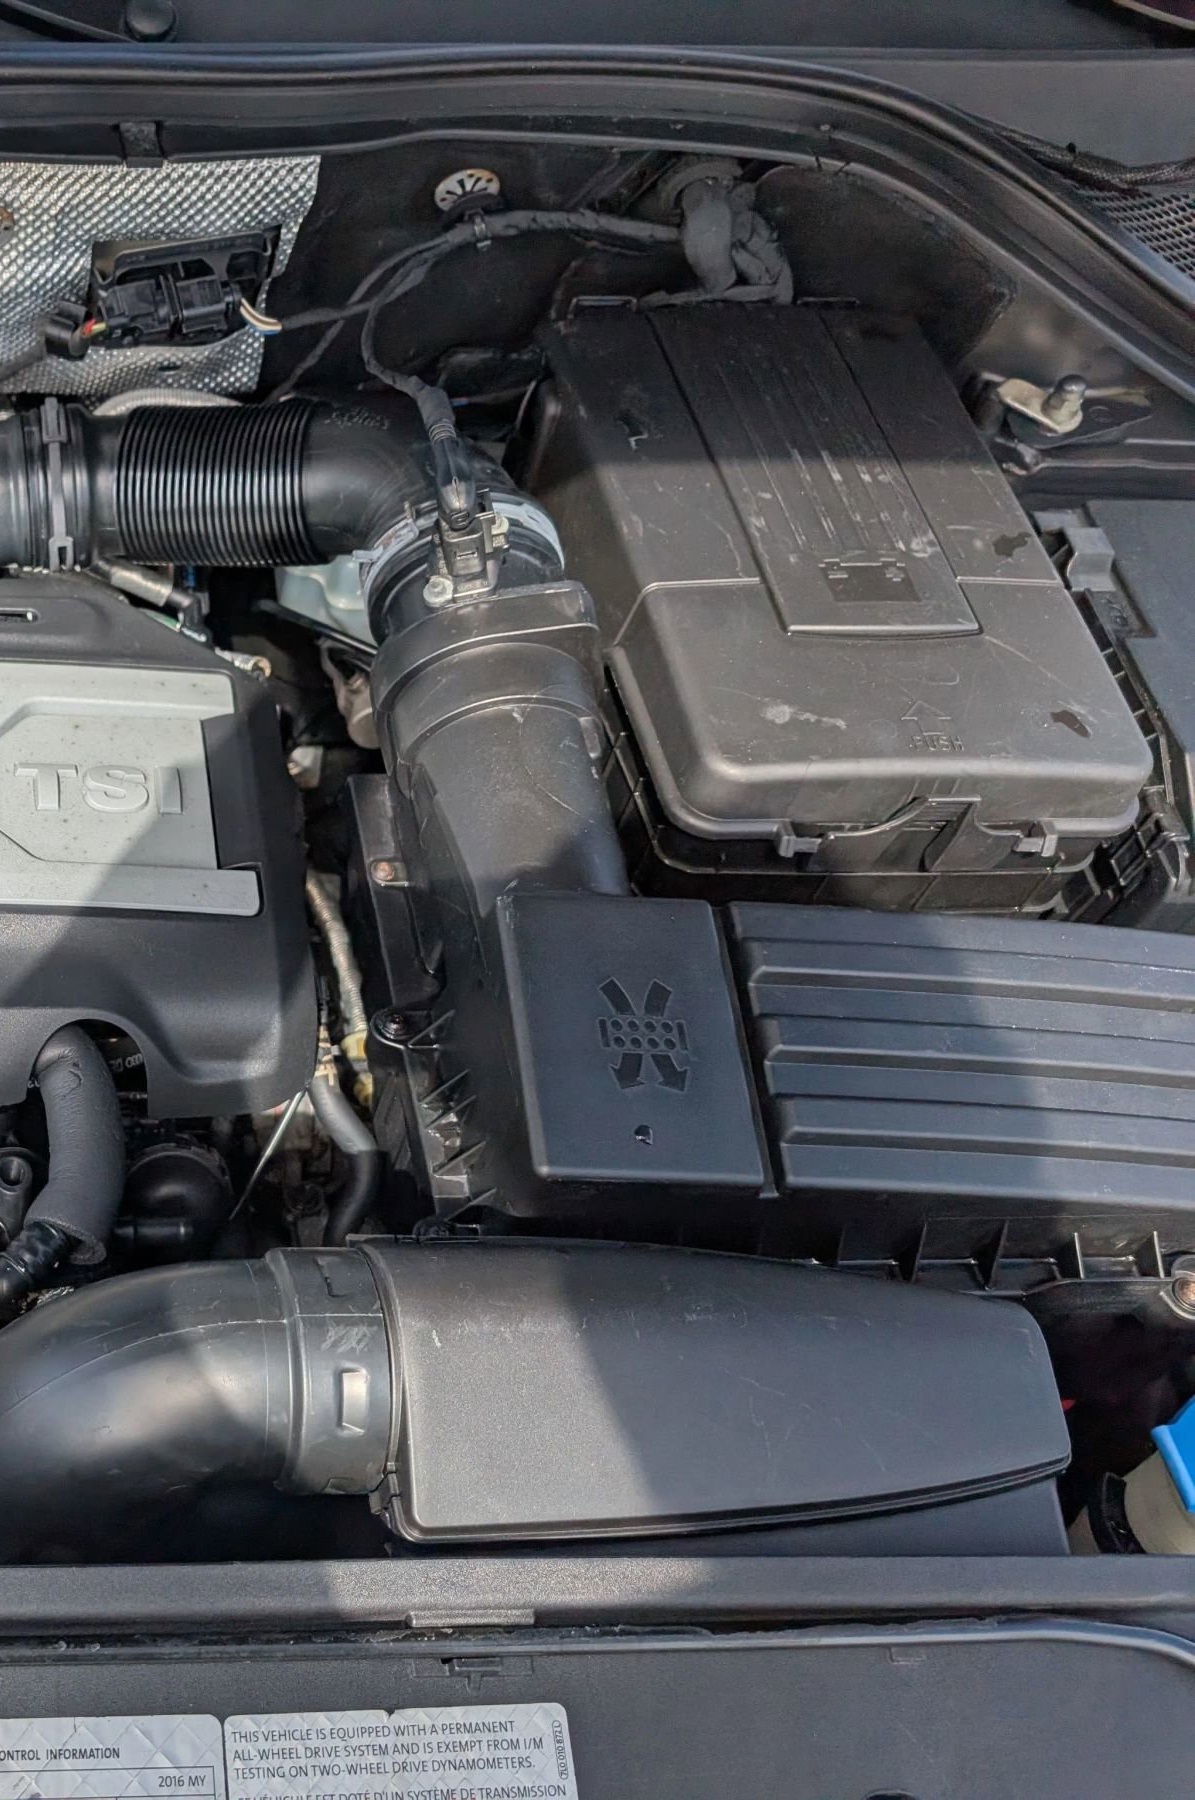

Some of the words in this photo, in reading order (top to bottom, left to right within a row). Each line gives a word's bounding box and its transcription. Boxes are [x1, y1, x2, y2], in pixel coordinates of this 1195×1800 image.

[13, 762, 183, 815] TSI
[230, 1730, 260, 1743] THIS
[261, 1728, 313, 1742] VEHICLE
[316, 1727, 327, 1740] IS
[329, 1725, 391, 1742] EQUIPPED
[392, 1724, 427, 1737] WITH
[429, 1723, 439, 1736] A
[441, 1720, 515, 1735] PERMANENT
[46, 1747, 120, 1761] INFORMATION
[232, 1747, 302, 1762] ALL-WHEEL
[304, 1745, 341, 1759] DRIVE
[344, 1743, 389, 1757] SYSTEM
[392, 1742, 420, 1756] AND
[423, 1741, 434, 1754] IS
[437, 1739, 483, 1754] EXEMPT
[487, 1738, 520, 1752] FROM
[523, 1736, 544, 1750] I/M
[556, 1746, 565, 1760] 010
[234, 1765, 286, 1780] TESTING
[288, 1764, 309, 1778] ON
[310, 1762, 390, 1777] TWO-WHEEL
[392, 1760, 429, 1774] DRIVE
[431, 1756, 536, 1773] DYNAMOMETERS.
[158, 1775, 185, 1788] 2016
[187, 1774, 207, 1787] MY
[460, 1787, 476, 1800] DE
[478, 1784, 567, 1800] TRANSMISSION
